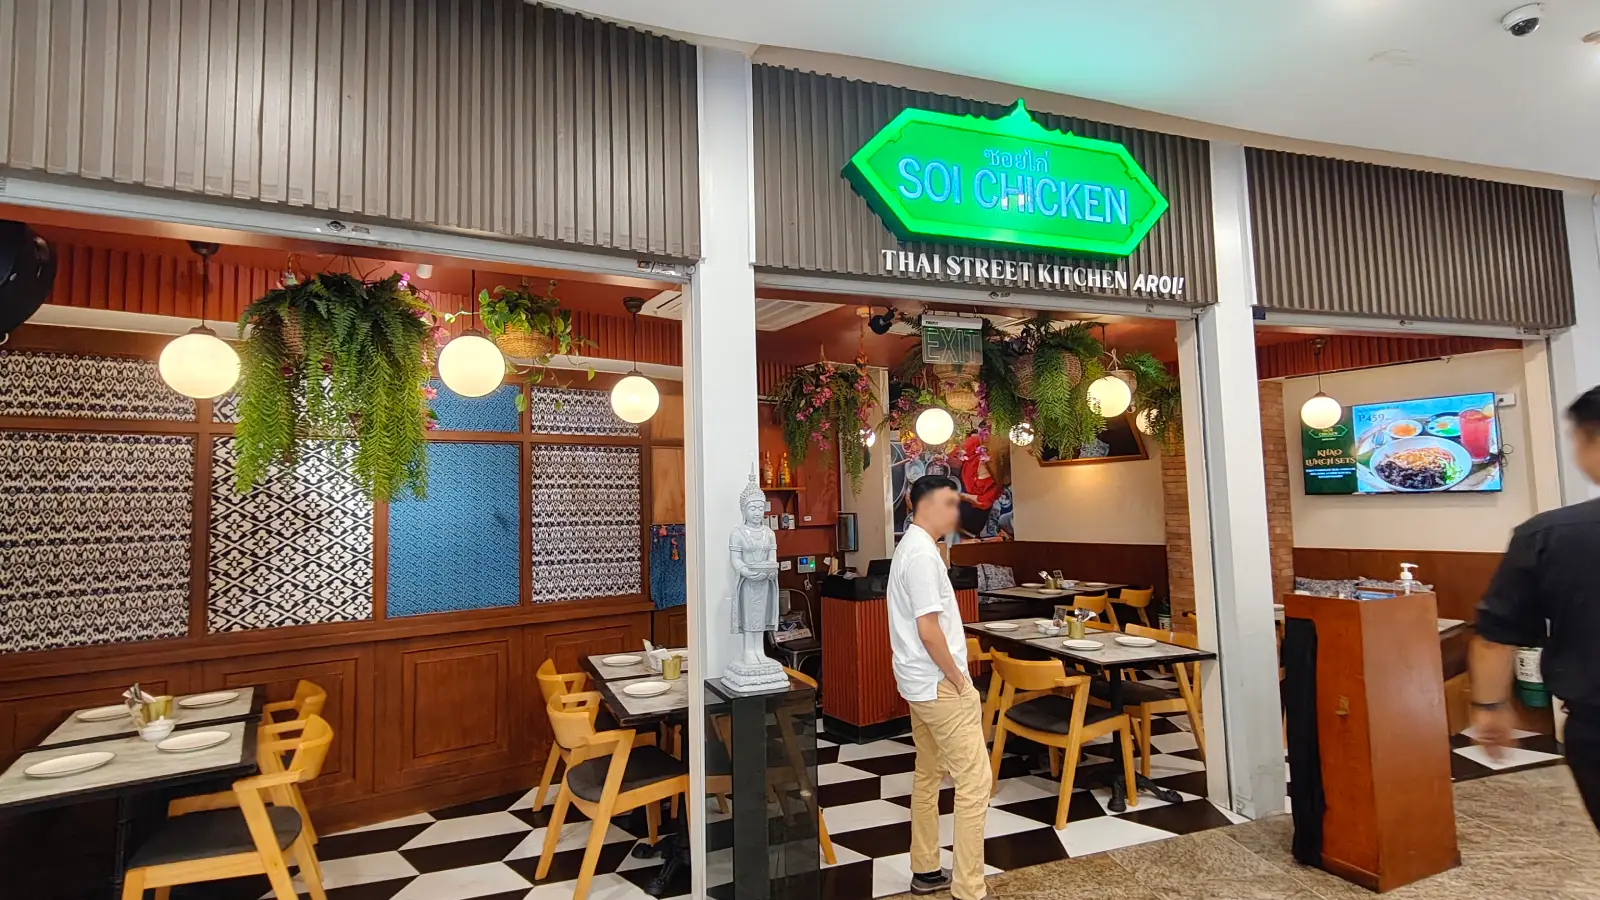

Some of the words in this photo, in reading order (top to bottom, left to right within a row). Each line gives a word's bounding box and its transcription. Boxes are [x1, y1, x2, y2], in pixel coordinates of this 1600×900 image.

[984, 148, 1048, 173] ซอยไก่
[899, 157, 962, 205] SOI
[973, 168, 1128, 225] CHICKEN
[881, 249, 941, 274] THAI
[946, 255, 1032, 283] STREET
[1038, 264, 1128, 290] KITCHEN
[1133, 273, 1184, 295] AROI!
[924, 327, 980, 363] EXIT
[1305, 457, 1334, 466] LUNCH
[1335, 457, 1356, 465] SETS
[1317, 448, 1343, 457] KHAO
